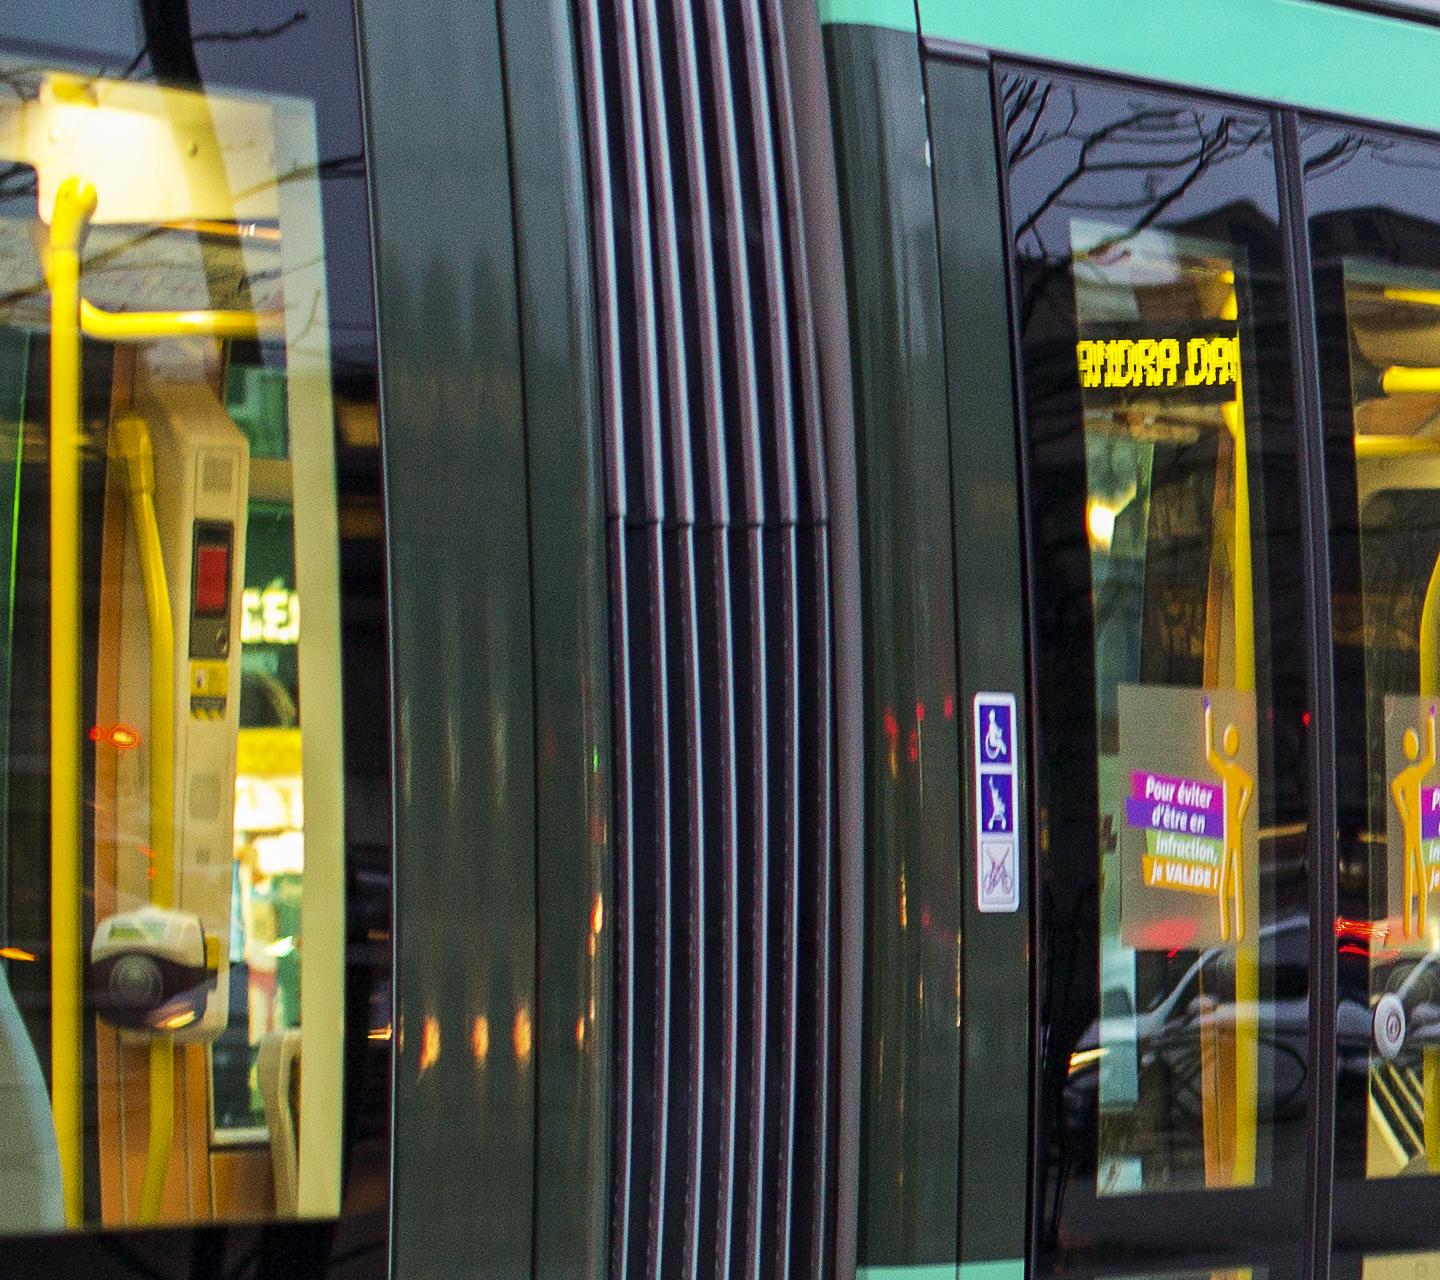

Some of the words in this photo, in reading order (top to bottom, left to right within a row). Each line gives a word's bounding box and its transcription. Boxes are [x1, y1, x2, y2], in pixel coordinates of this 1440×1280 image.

[1145, 775, 1176, 803] Pour
[1178, 780, 1213, 809] éviter
[1151, 803, 1188, 831] d'être
[1190, 812, 1206, 834] en
[1166, 861, 1211, 889] VALIDE
